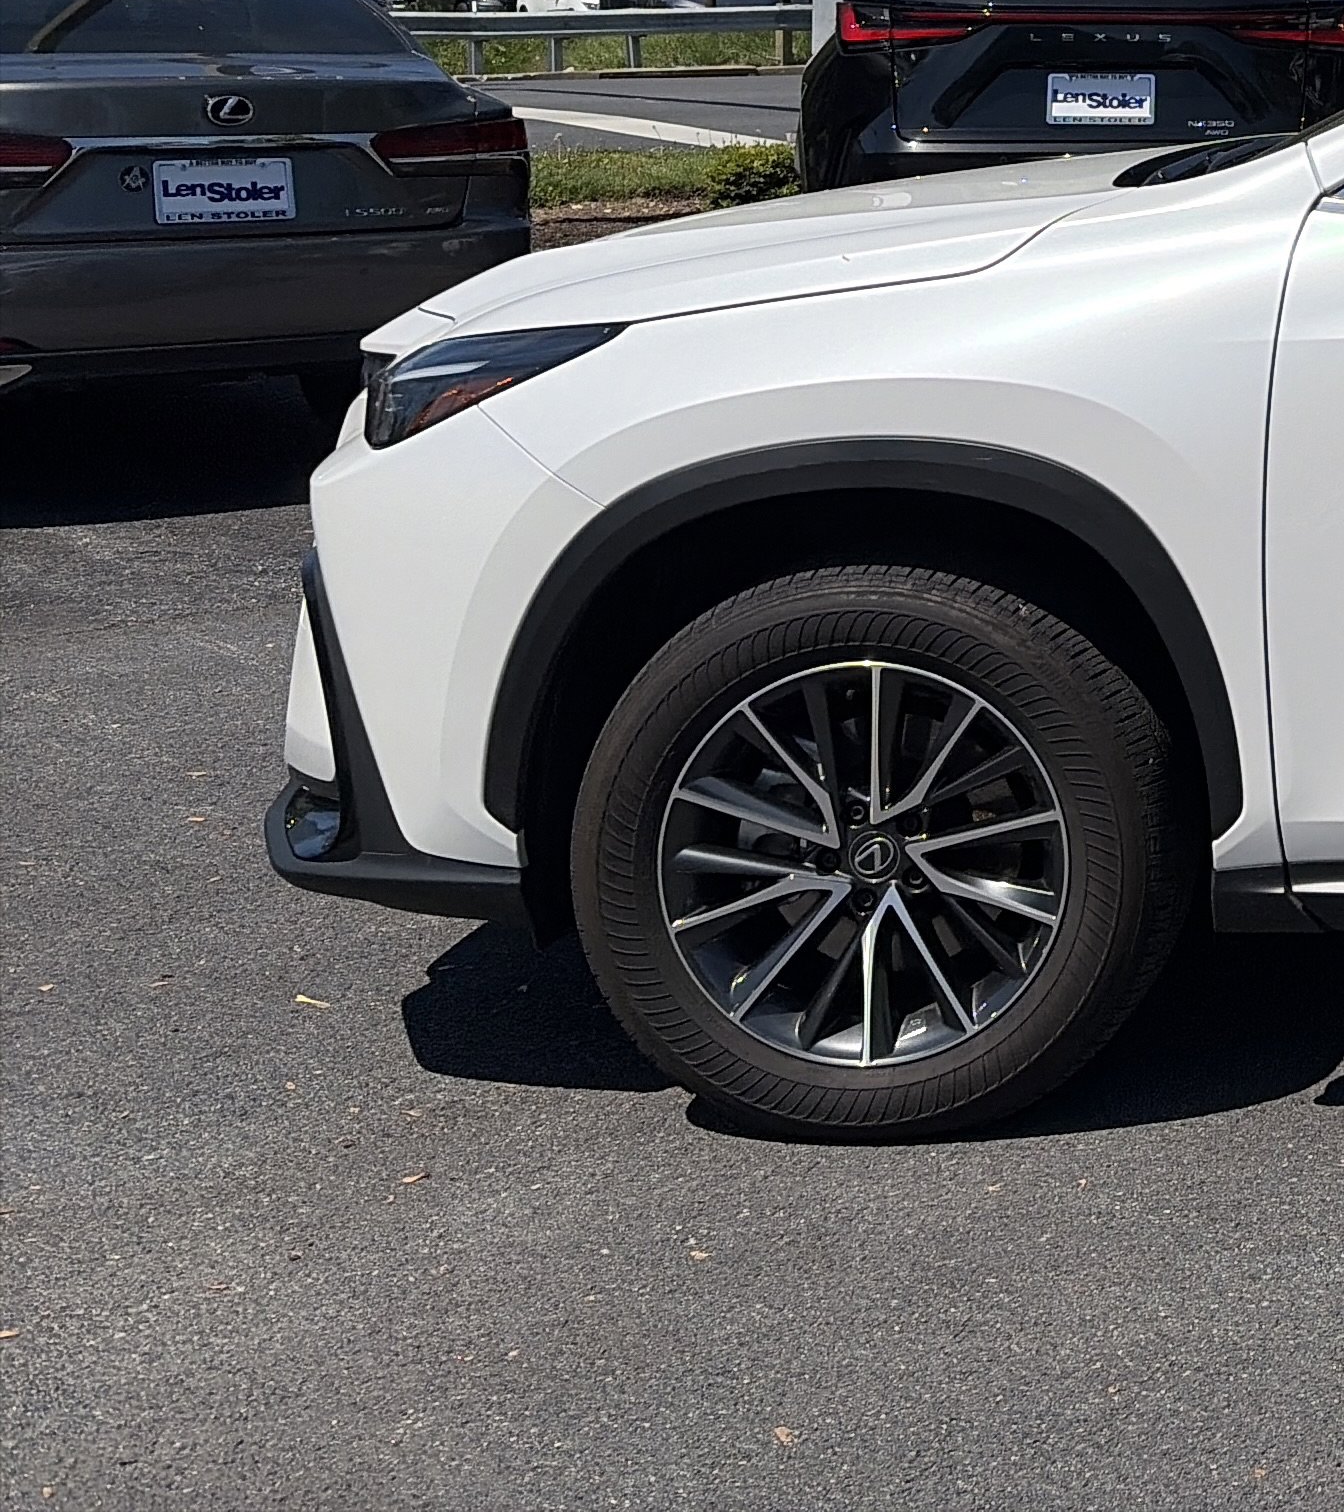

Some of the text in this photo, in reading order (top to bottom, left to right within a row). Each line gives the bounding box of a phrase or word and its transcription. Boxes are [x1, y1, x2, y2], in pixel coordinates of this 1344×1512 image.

[1030, 33, 1172, 43] LEXUS
[165, 210, 288, 221] LEN STOLER
